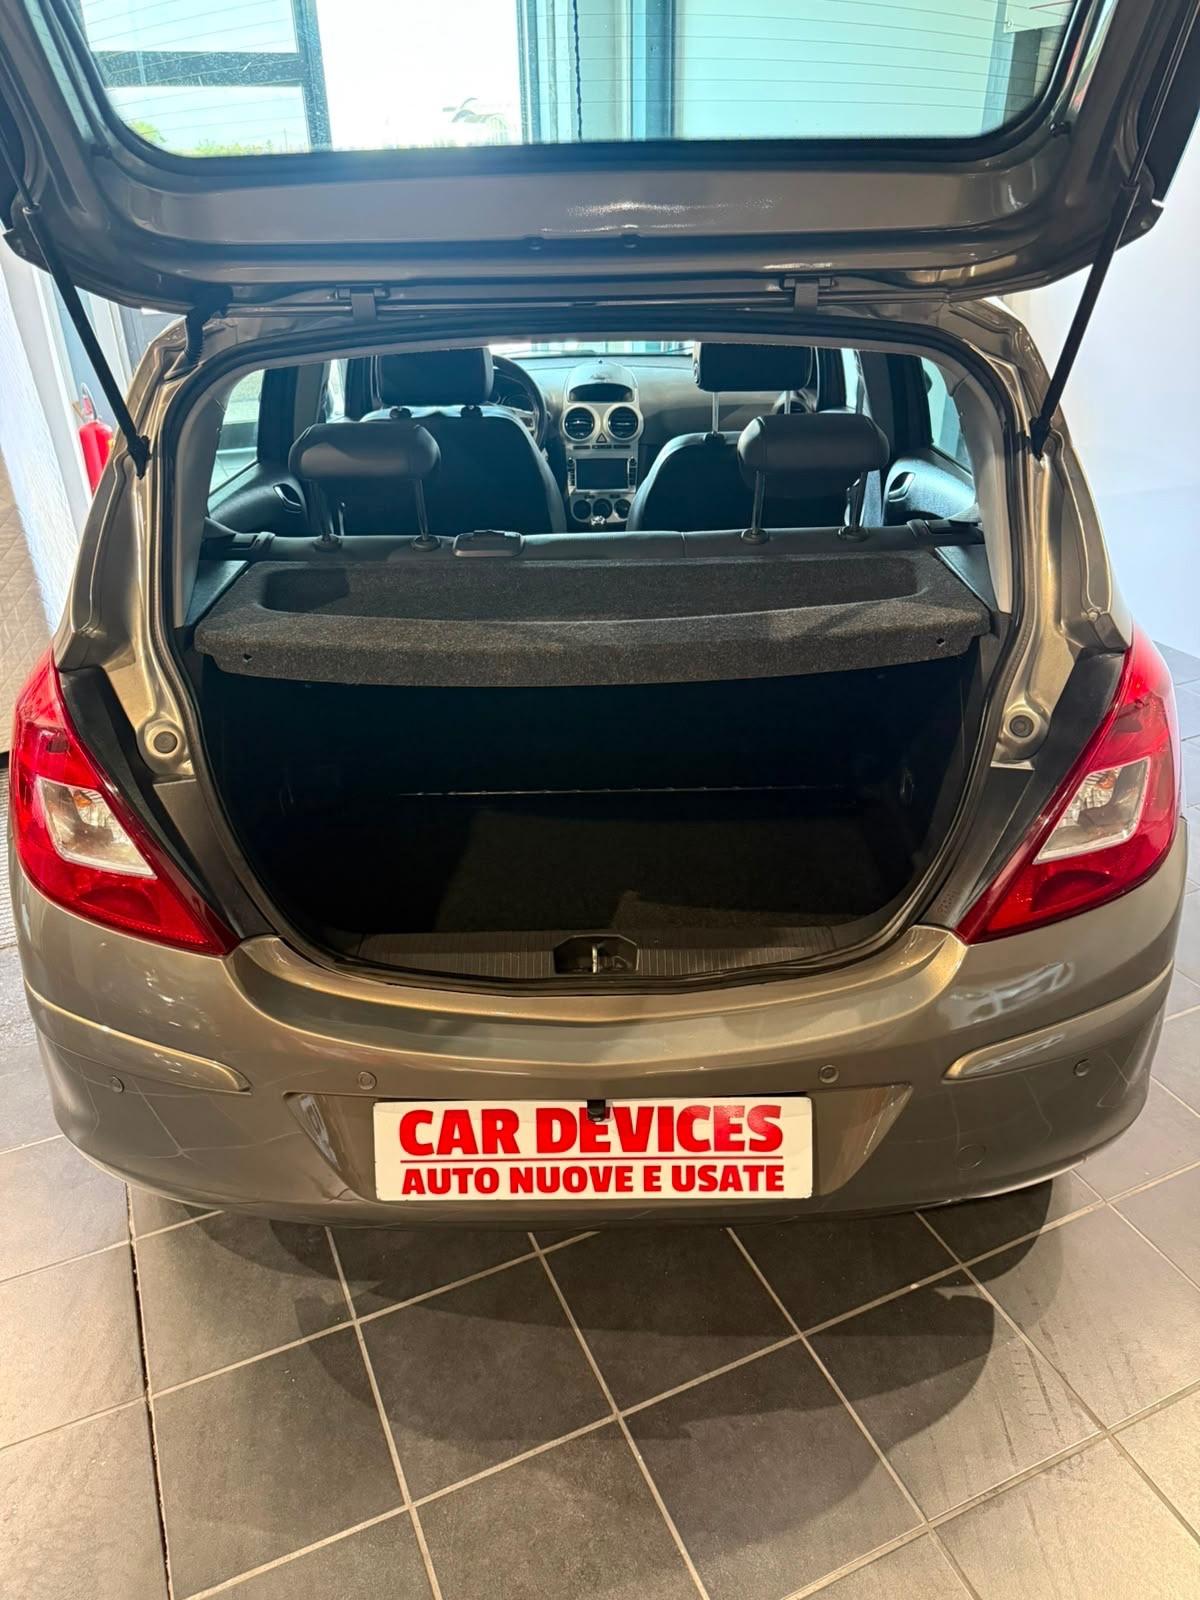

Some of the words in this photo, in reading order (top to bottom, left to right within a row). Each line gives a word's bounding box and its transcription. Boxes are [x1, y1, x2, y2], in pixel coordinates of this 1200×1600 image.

[398, 1107, 521, 1156] CAR
[534, 1104, 785, 1154] DEVICES
[401, 1166, 501, 1196] AUTO
[508, 1165, 635, 1194] NUOVE
[642, 1164, 663, 1193] E
[671, 1163, 785, 1193] USATE
